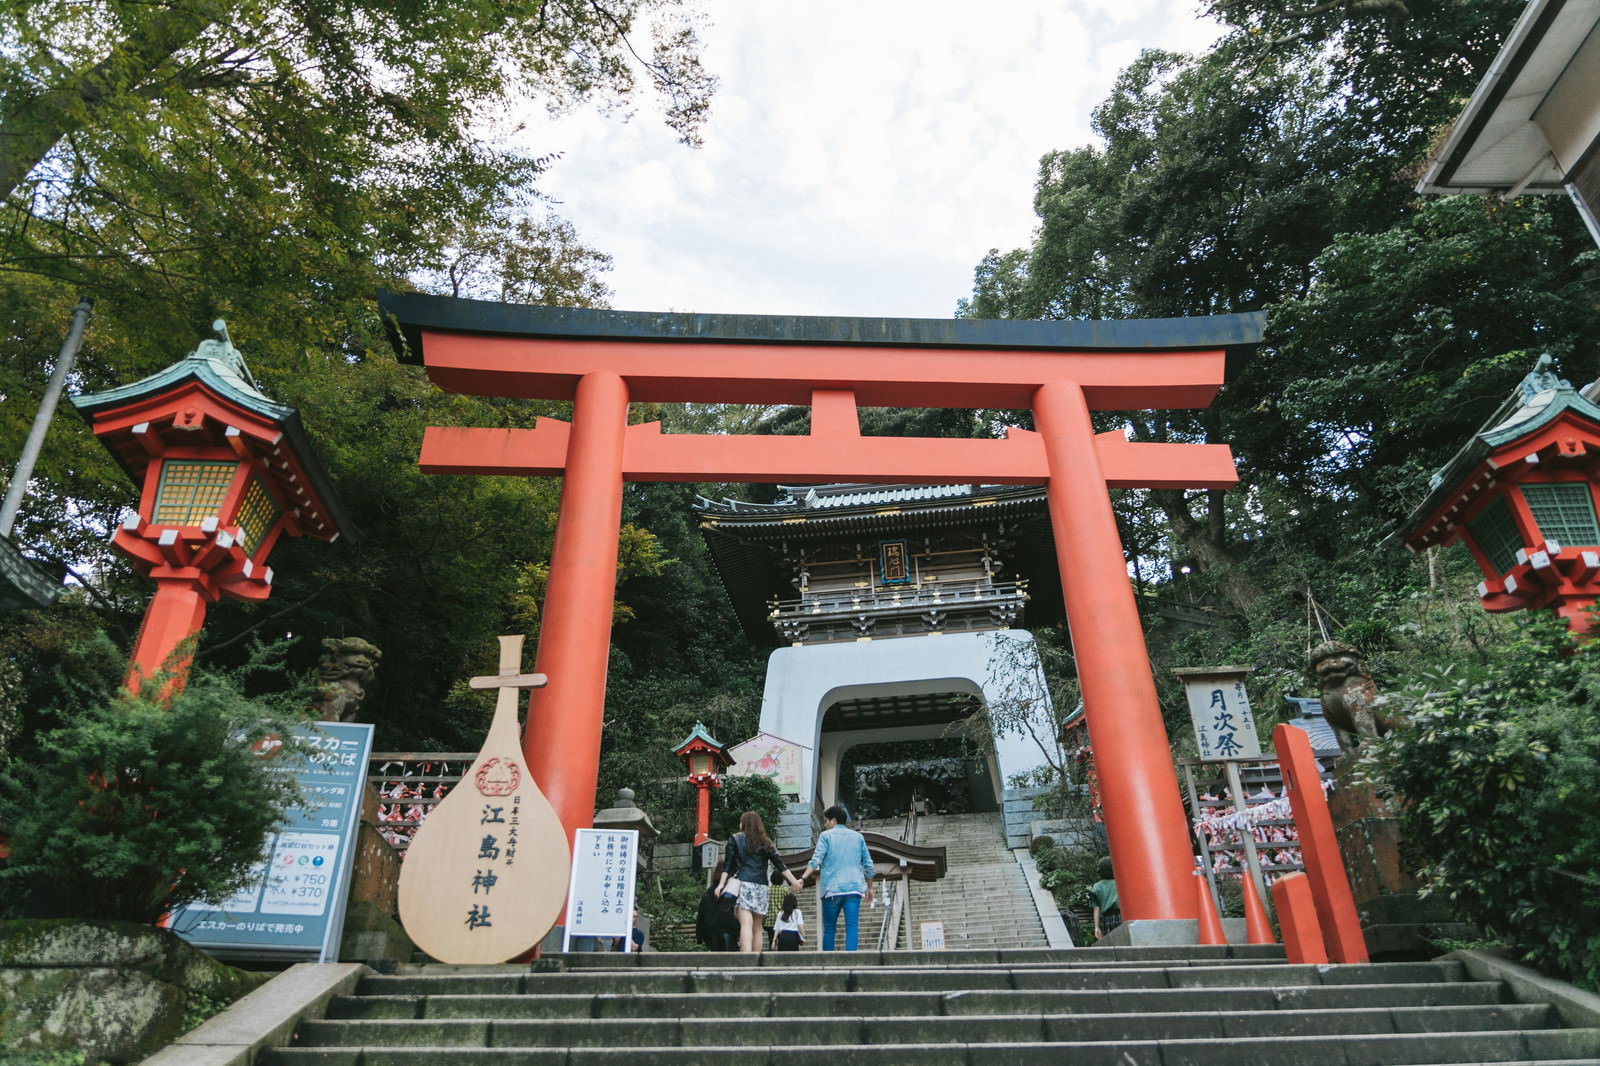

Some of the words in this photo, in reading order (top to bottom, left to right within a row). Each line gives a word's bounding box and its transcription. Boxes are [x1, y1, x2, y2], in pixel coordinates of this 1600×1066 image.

[1209, 689, 1244, 757] 月次祭
[465, 803, 506, 931] 江島神社
[593, 835, 602, 857] 下さい
